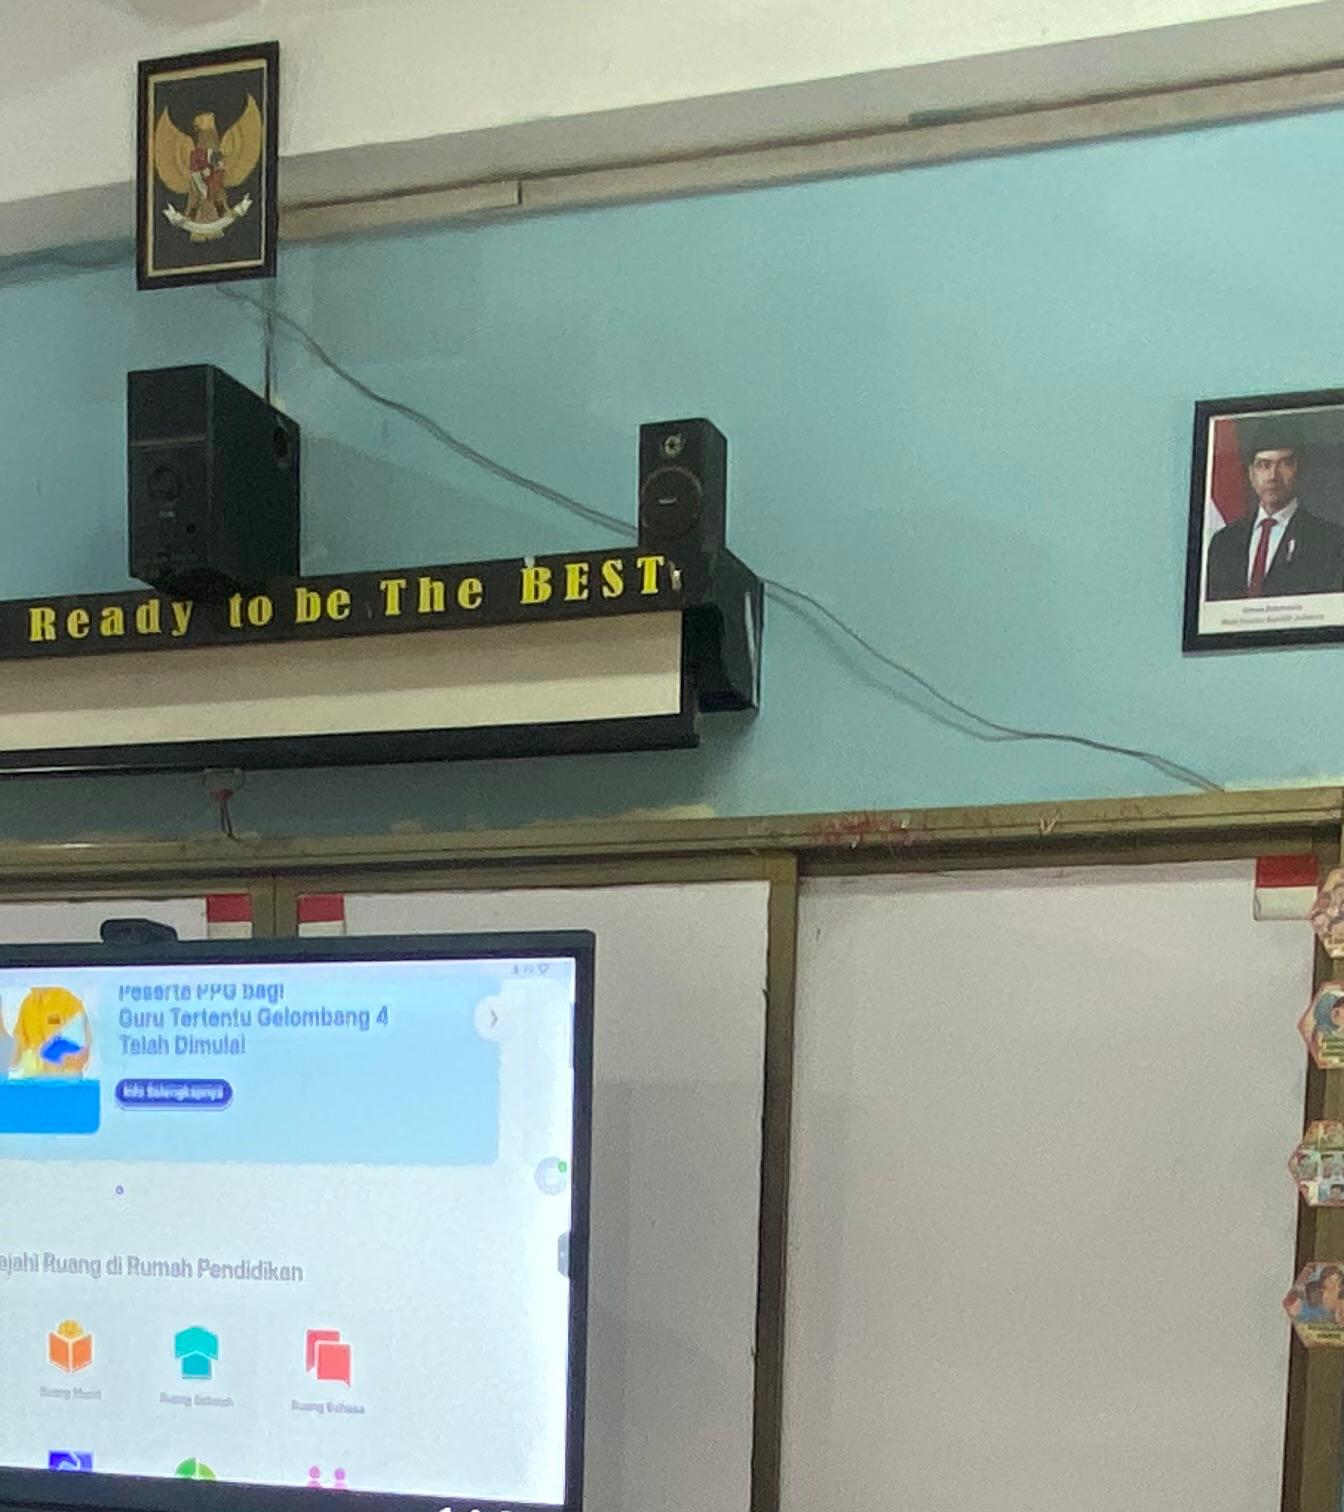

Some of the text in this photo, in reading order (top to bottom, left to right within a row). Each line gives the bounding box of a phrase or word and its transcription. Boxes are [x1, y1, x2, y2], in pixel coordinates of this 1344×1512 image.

[27, 598, 194, 644] Ready
[228, 591, 273, 629] to
[294, 585, 352, 625] be
[378, 575, 484, 617] The
[118, 1004, 389, 1031] Guru Tertentu Gelombang 4
[118, 1033, 170, 1056] Telah
[43, 1252, 102, 1279] Ruang
[106, 1254, 123, 1277] di
[127, 1255, 193, 1279] Rumah
[197, 1258, 304, 1282] Pendidikan
